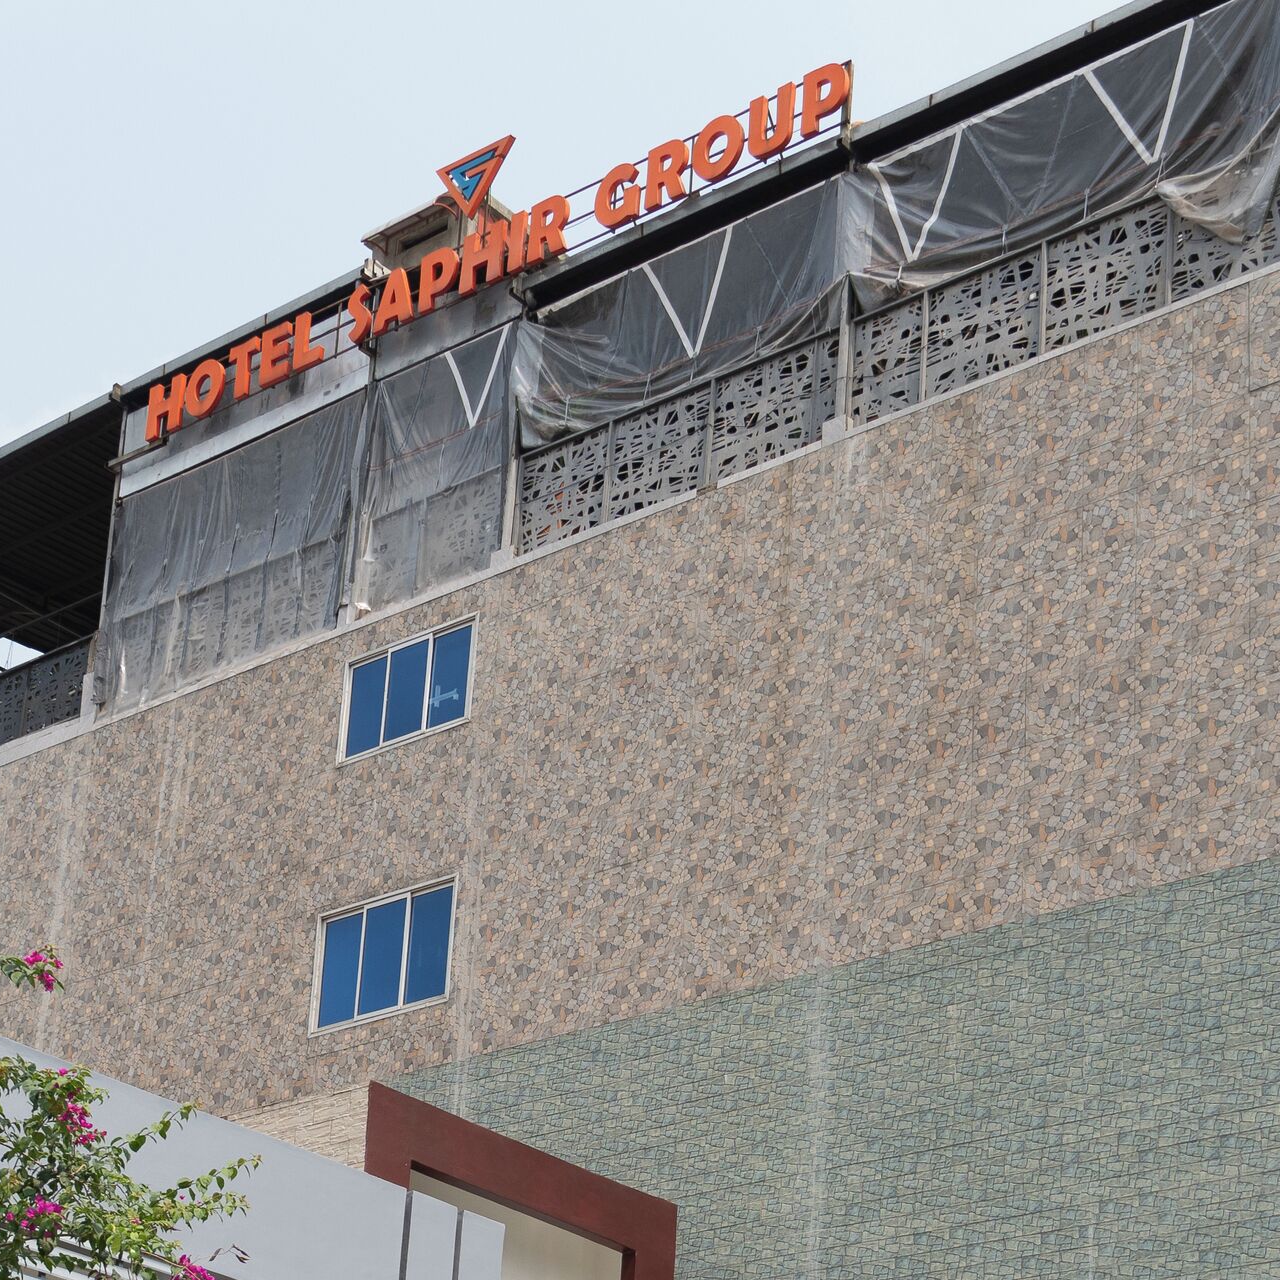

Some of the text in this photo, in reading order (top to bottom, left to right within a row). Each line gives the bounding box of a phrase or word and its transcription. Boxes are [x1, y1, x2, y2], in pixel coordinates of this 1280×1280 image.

[145, 63, 849, 442] HOTEL SAPHIR GROUP
